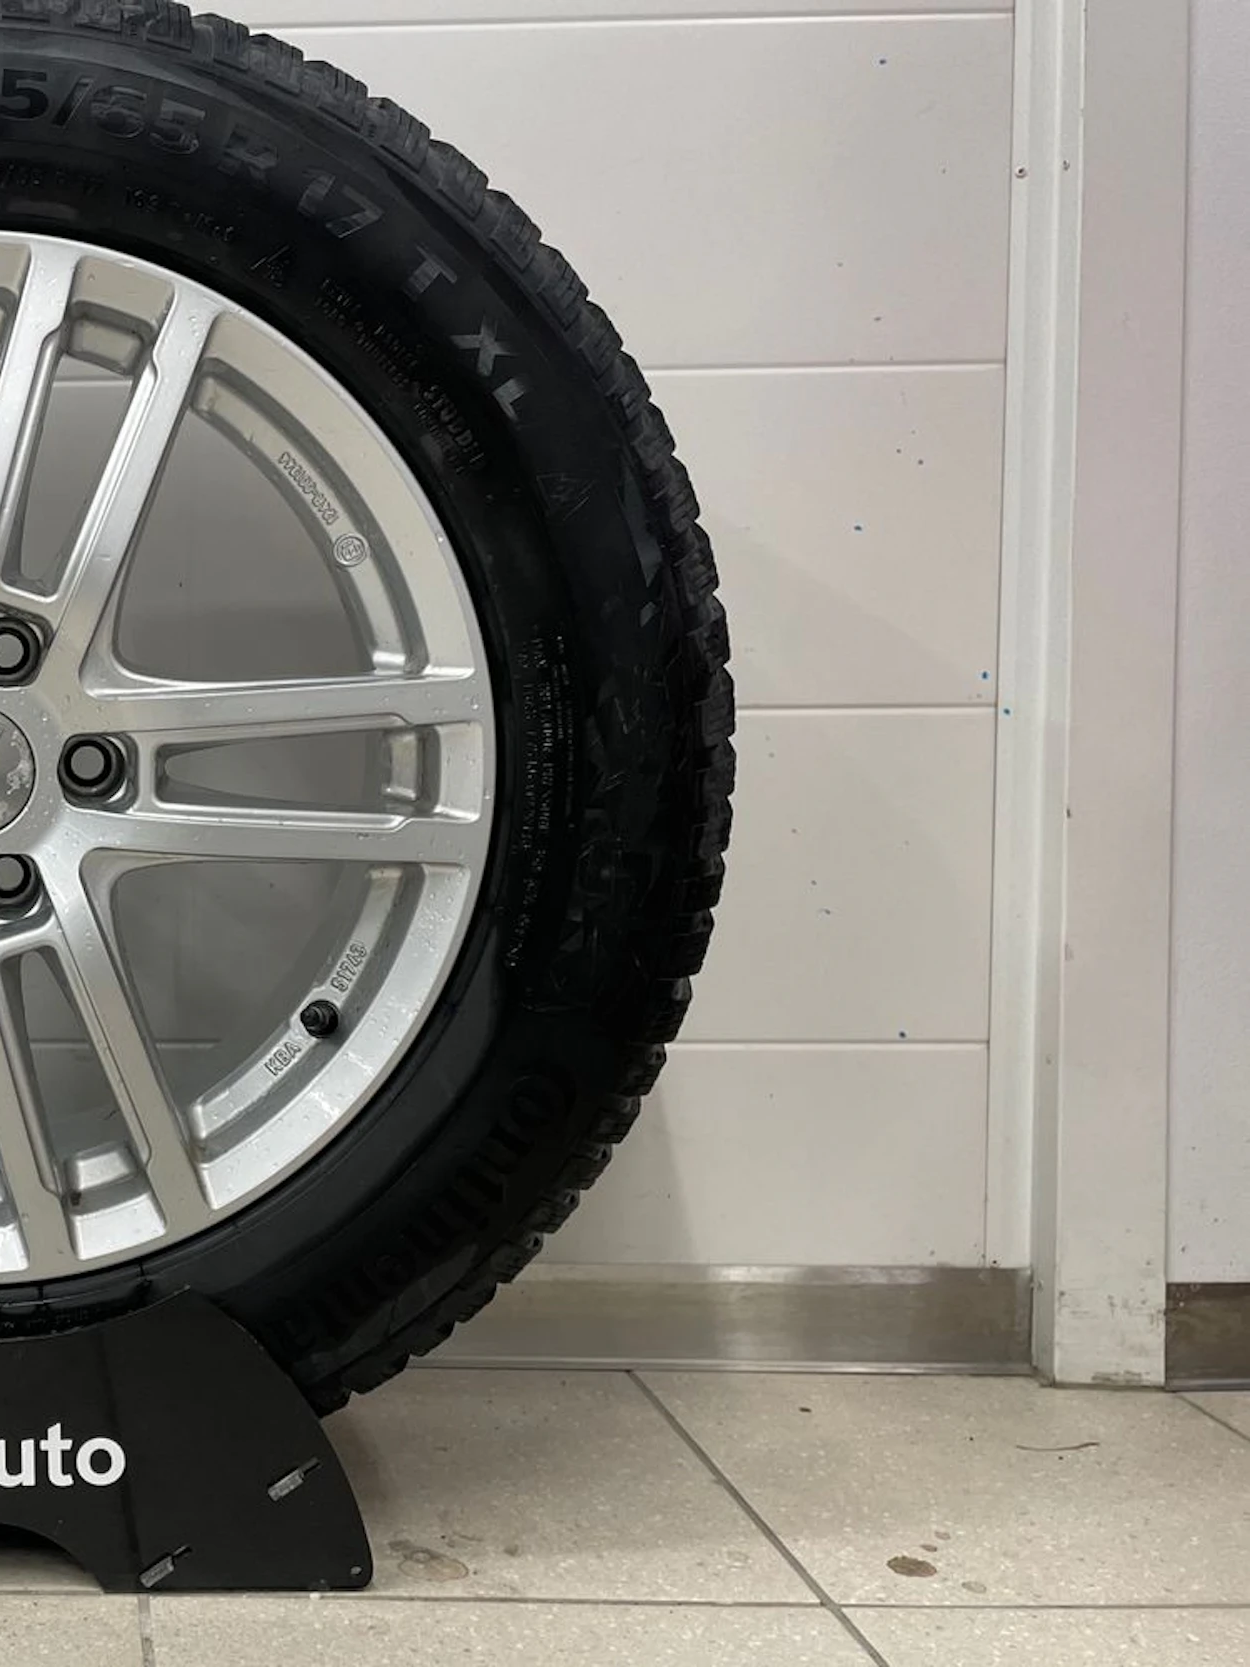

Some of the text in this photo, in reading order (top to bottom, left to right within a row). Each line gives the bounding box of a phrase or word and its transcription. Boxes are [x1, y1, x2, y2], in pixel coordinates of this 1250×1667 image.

[217, 122, 280, 183] R
[297, 167, 387, 241] 17
[449, 313, 528, 431] XL
[263, 1041, 302, 1077] KBA
